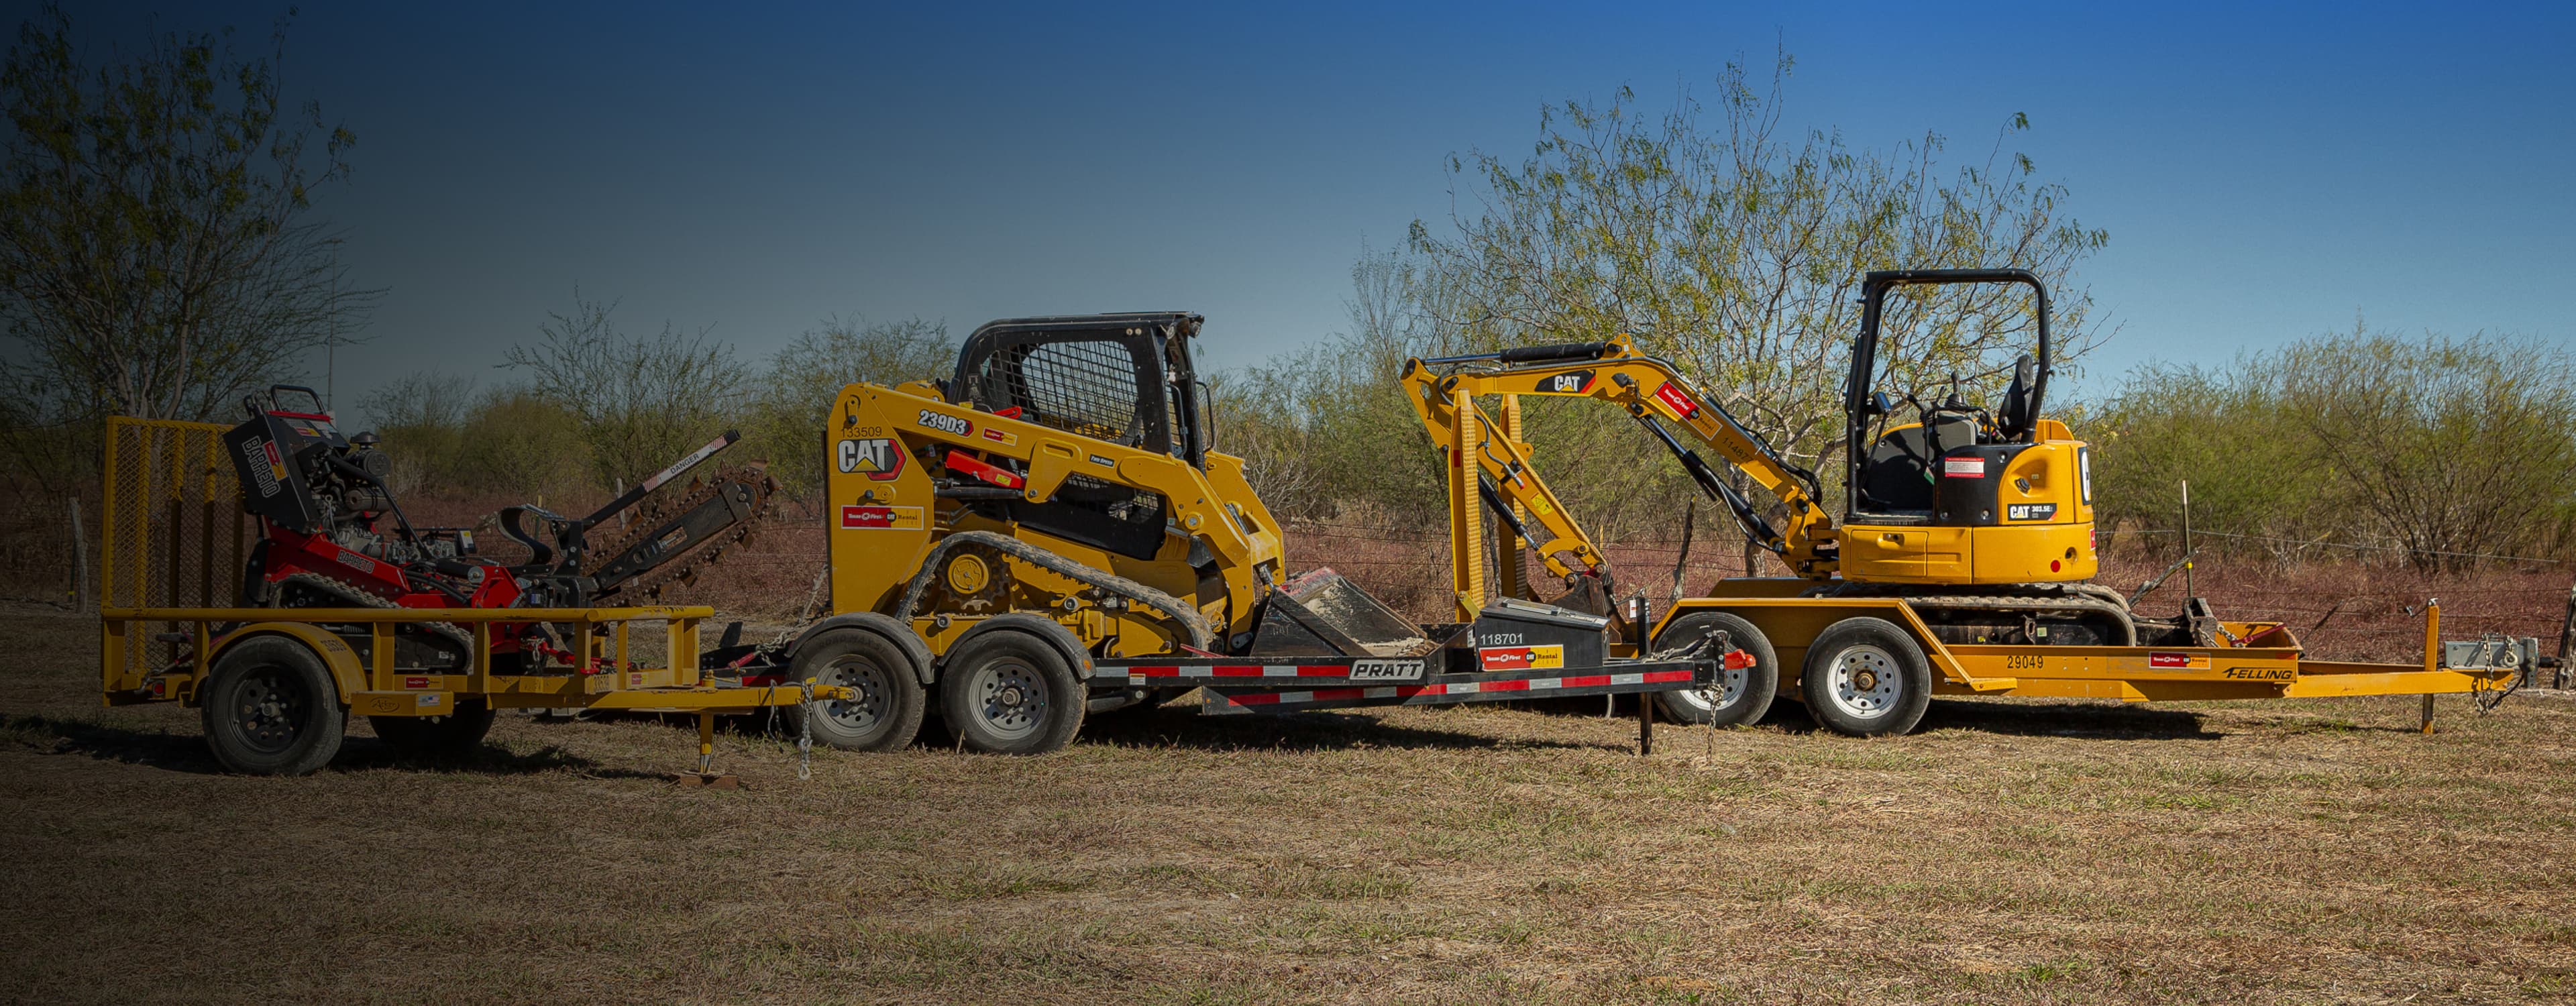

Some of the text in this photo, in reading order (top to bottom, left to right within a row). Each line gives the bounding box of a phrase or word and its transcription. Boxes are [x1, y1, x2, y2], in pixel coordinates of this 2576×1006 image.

[1554, 375, 1580, 392] CAT
[918, 410, 967, 435] 239D3
[841, 427, 882, 437] 133509
[670, 453, 699, 473] DANGER
[838, 439, 890, 473] CAT
[241, 435, 281, 498] BARRETO
[2010, 506, 2030, 518] CAT
[336, 549, 376, 574] BARRETO
[1481, 633, 1523, 645] 118701
[2007, 655, 2043, 669] 29049
[1354, 664, 1421, 677] PRATT
[2222, 667, 2293, 679] FELLING
